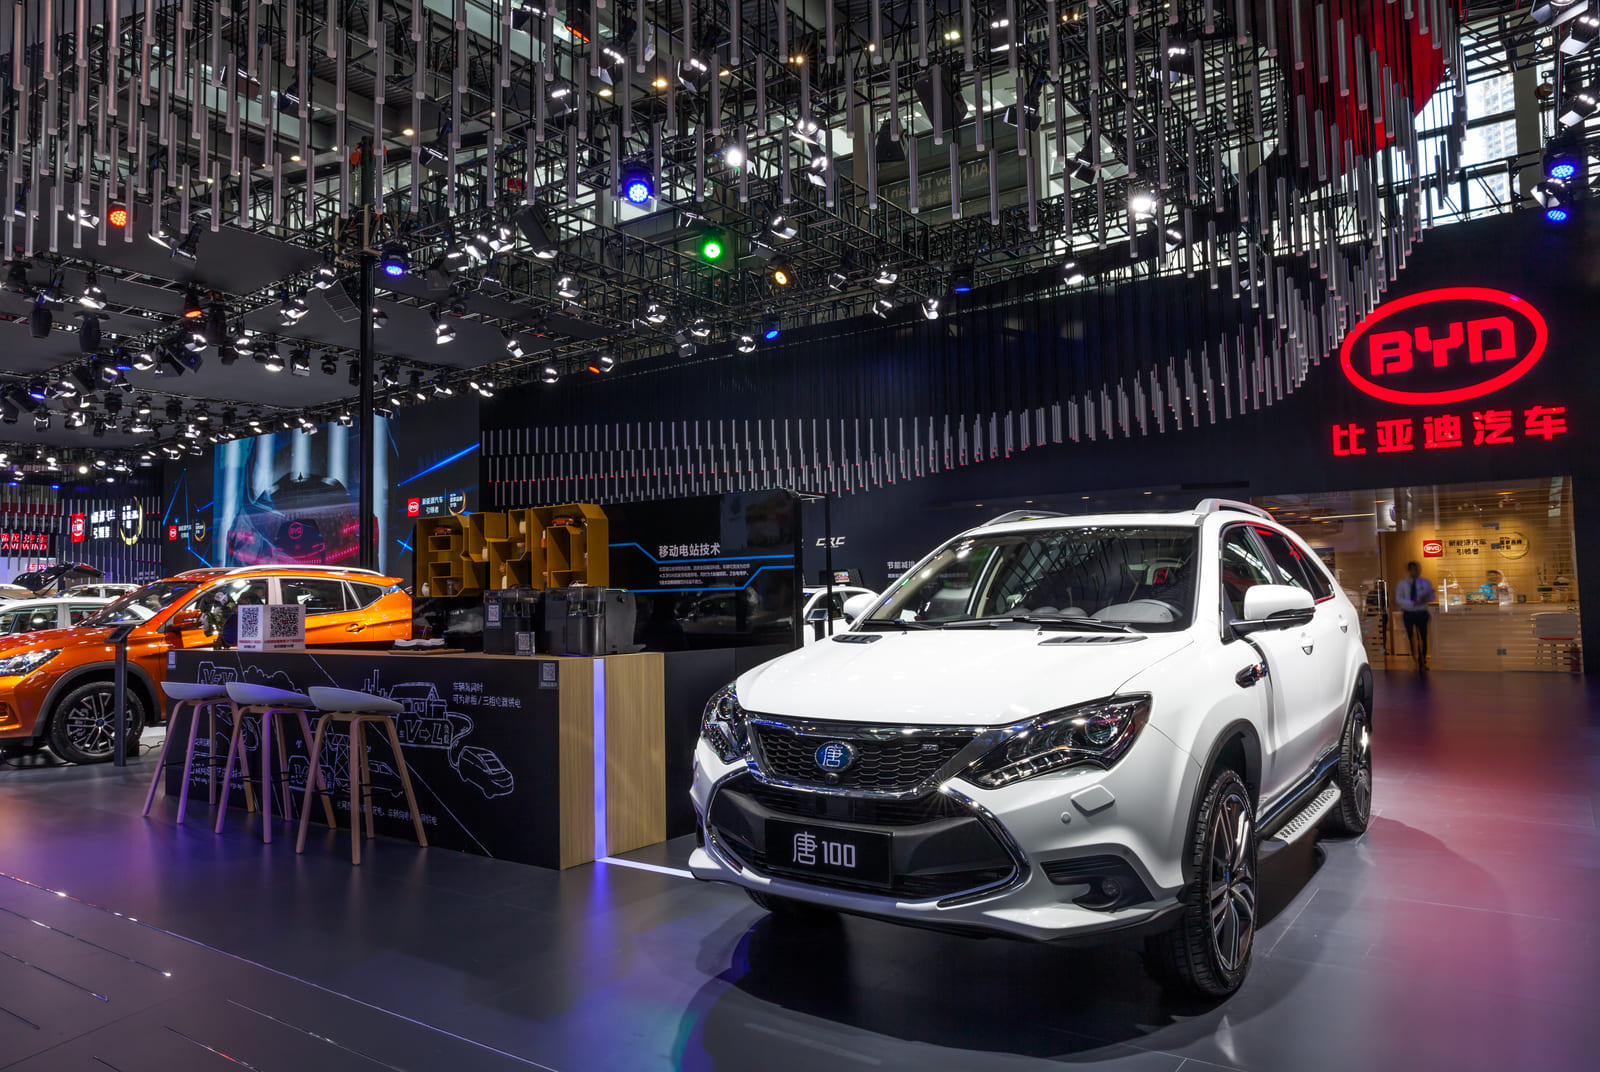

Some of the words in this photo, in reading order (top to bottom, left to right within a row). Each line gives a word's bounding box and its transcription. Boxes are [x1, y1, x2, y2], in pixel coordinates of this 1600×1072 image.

[1368, 316, 1516, 376] BYD
[1331, 405, 1568, 456] 比亚迪汽车
[658, 543, 721, 558] 移动电站技术
[822, 743, 843, 767] 唐
